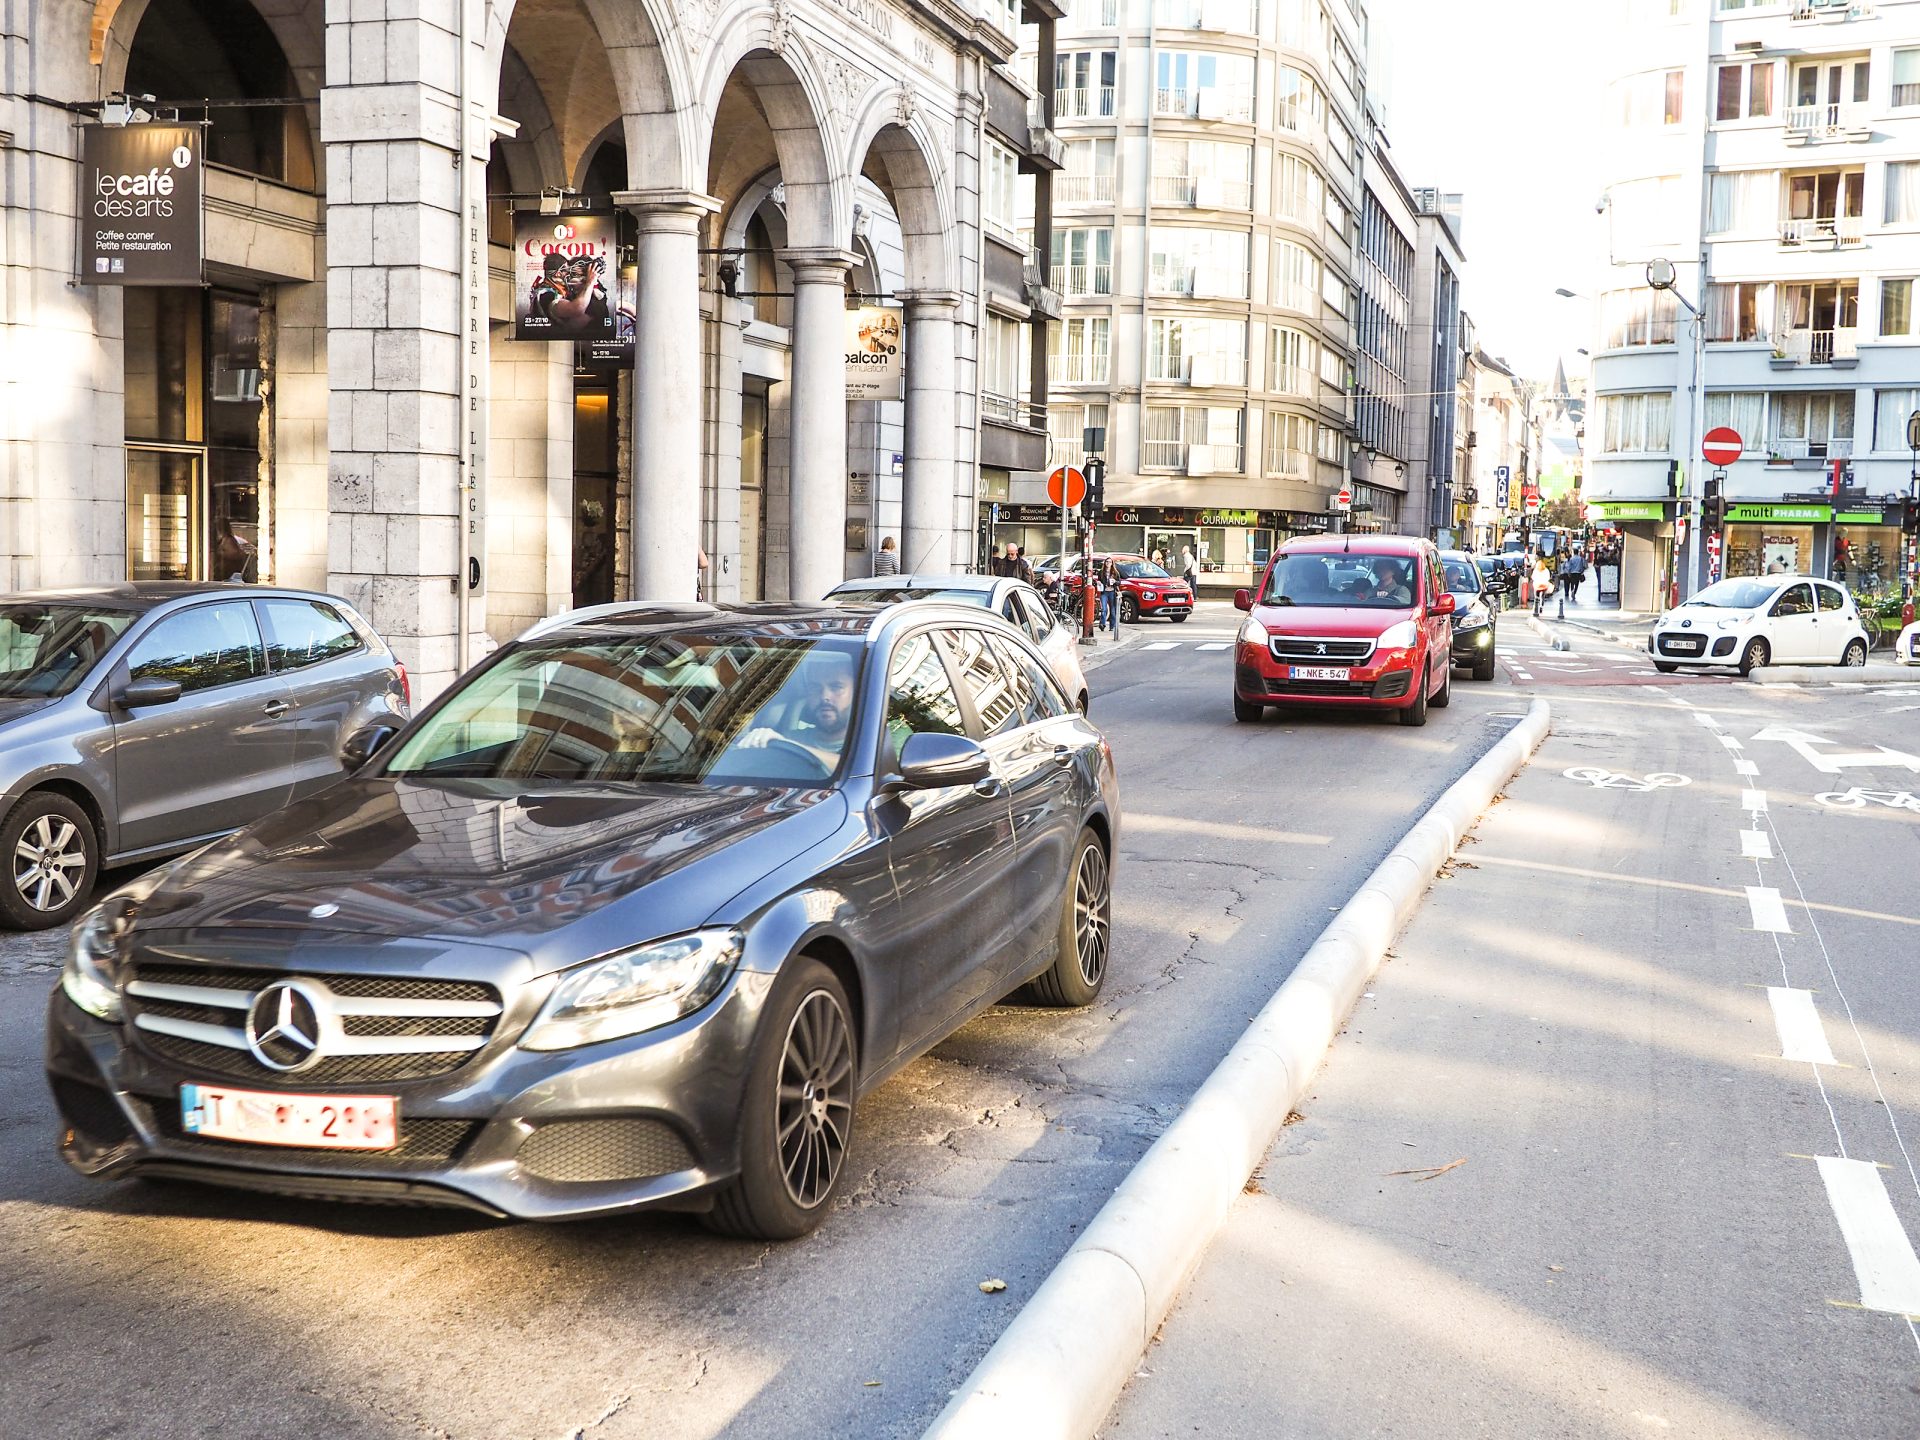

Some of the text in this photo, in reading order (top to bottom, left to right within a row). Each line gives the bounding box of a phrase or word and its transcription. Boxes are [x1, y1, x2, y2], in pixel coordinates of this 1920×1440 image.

[94, 195, 174, 217] des arts
[95, 230, 155, 240] Coffee corner
[95, 241, 172, 251] Petite restauration
[524, 237, 595, 257] Cocon
[469, 374, 478, 412] DE
[1115, 509, 1139, 523] COIN
[1194, 510, 1248, 526] GOURMAND
